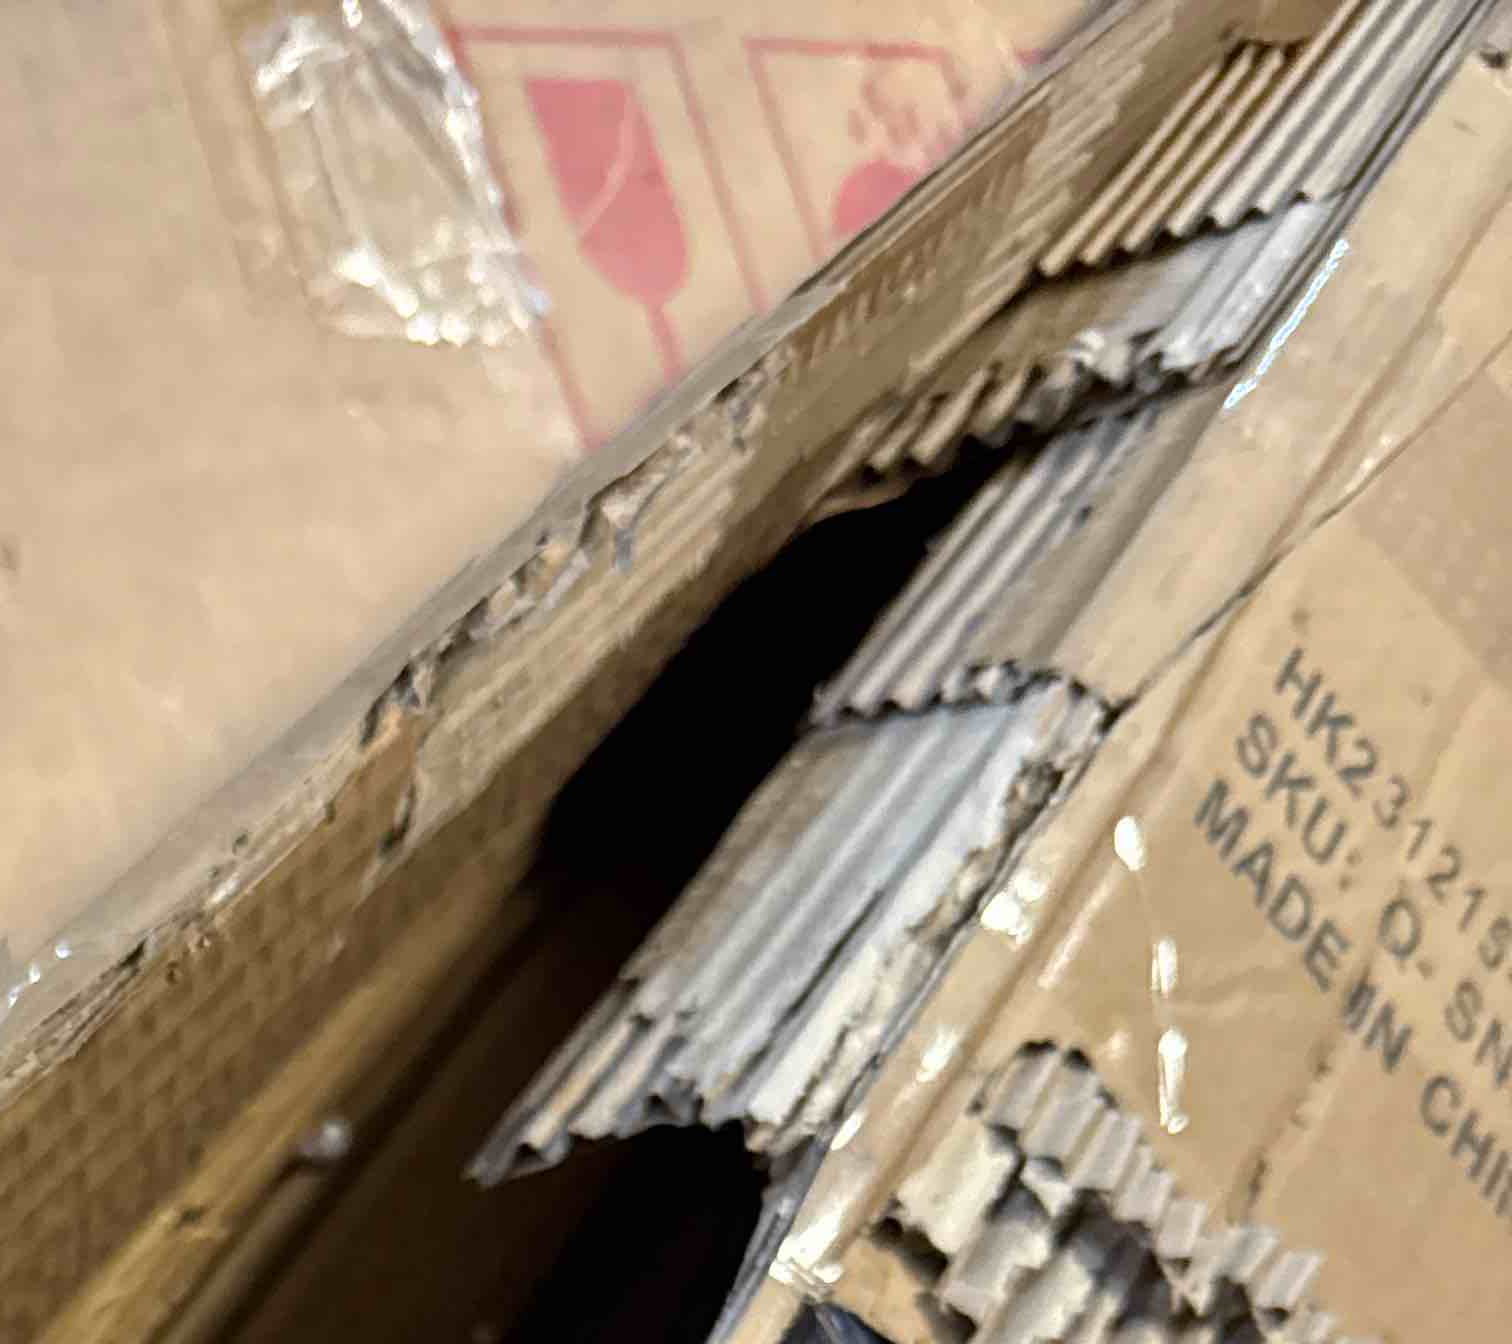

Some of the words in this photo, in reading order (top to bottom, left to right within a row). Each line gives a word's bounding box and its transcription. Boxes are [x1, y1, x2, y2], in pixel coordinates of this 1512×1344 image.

[1235, 713, 1362, 890] SKU:
[1192, 777, 1353, 993] MADE
[1342, 978, 1414, 1074] IN
